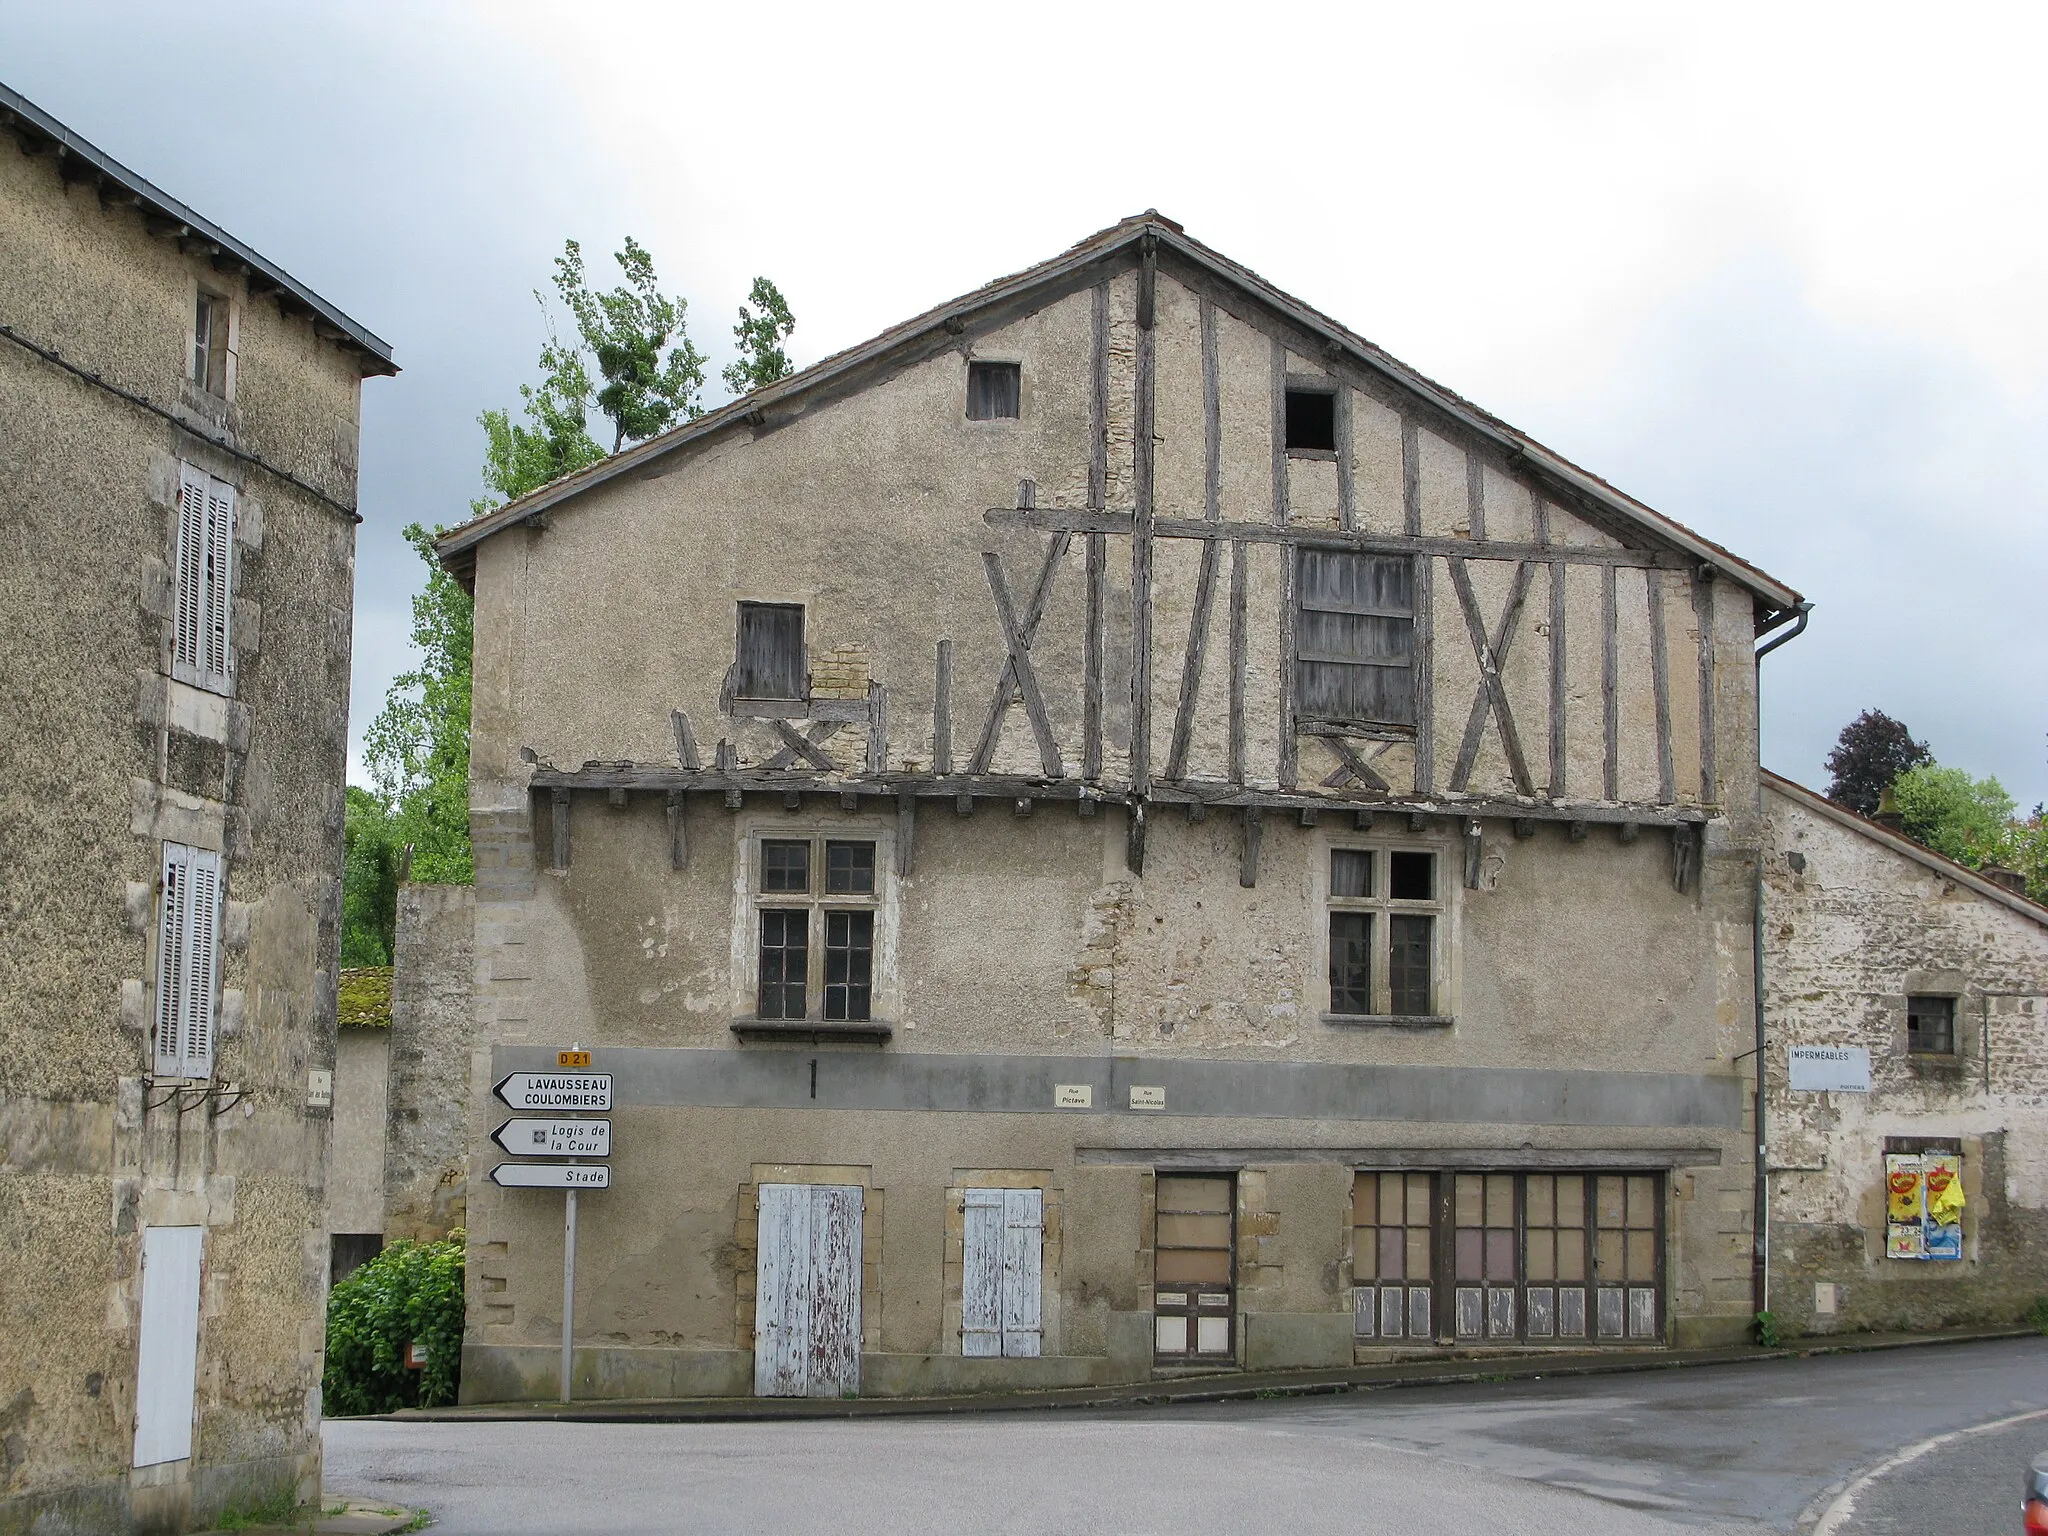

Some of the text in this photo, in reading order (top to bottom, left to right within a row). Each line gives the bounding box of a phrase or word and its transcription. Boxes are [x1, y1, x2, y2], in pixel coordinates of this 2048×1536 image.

[560, 1054, 589, 1064] D 21
[1791, 1050, 1849, 1061] IMPERMÉABLES
[528, 1079, 607, 1090] LAVAUSSEAU
[525, 1094, 606, 1106] COULOMBIERS
[1062, 1096, 1085, 1104] Pictave
[1131, 1098, 1164, 1106] Saint-Nicolas
[551, 1125, 605, 1138] Logis de
[551, 1140, 599, 1151] la Cour
[566, 1170, 604, 1182] Stade
